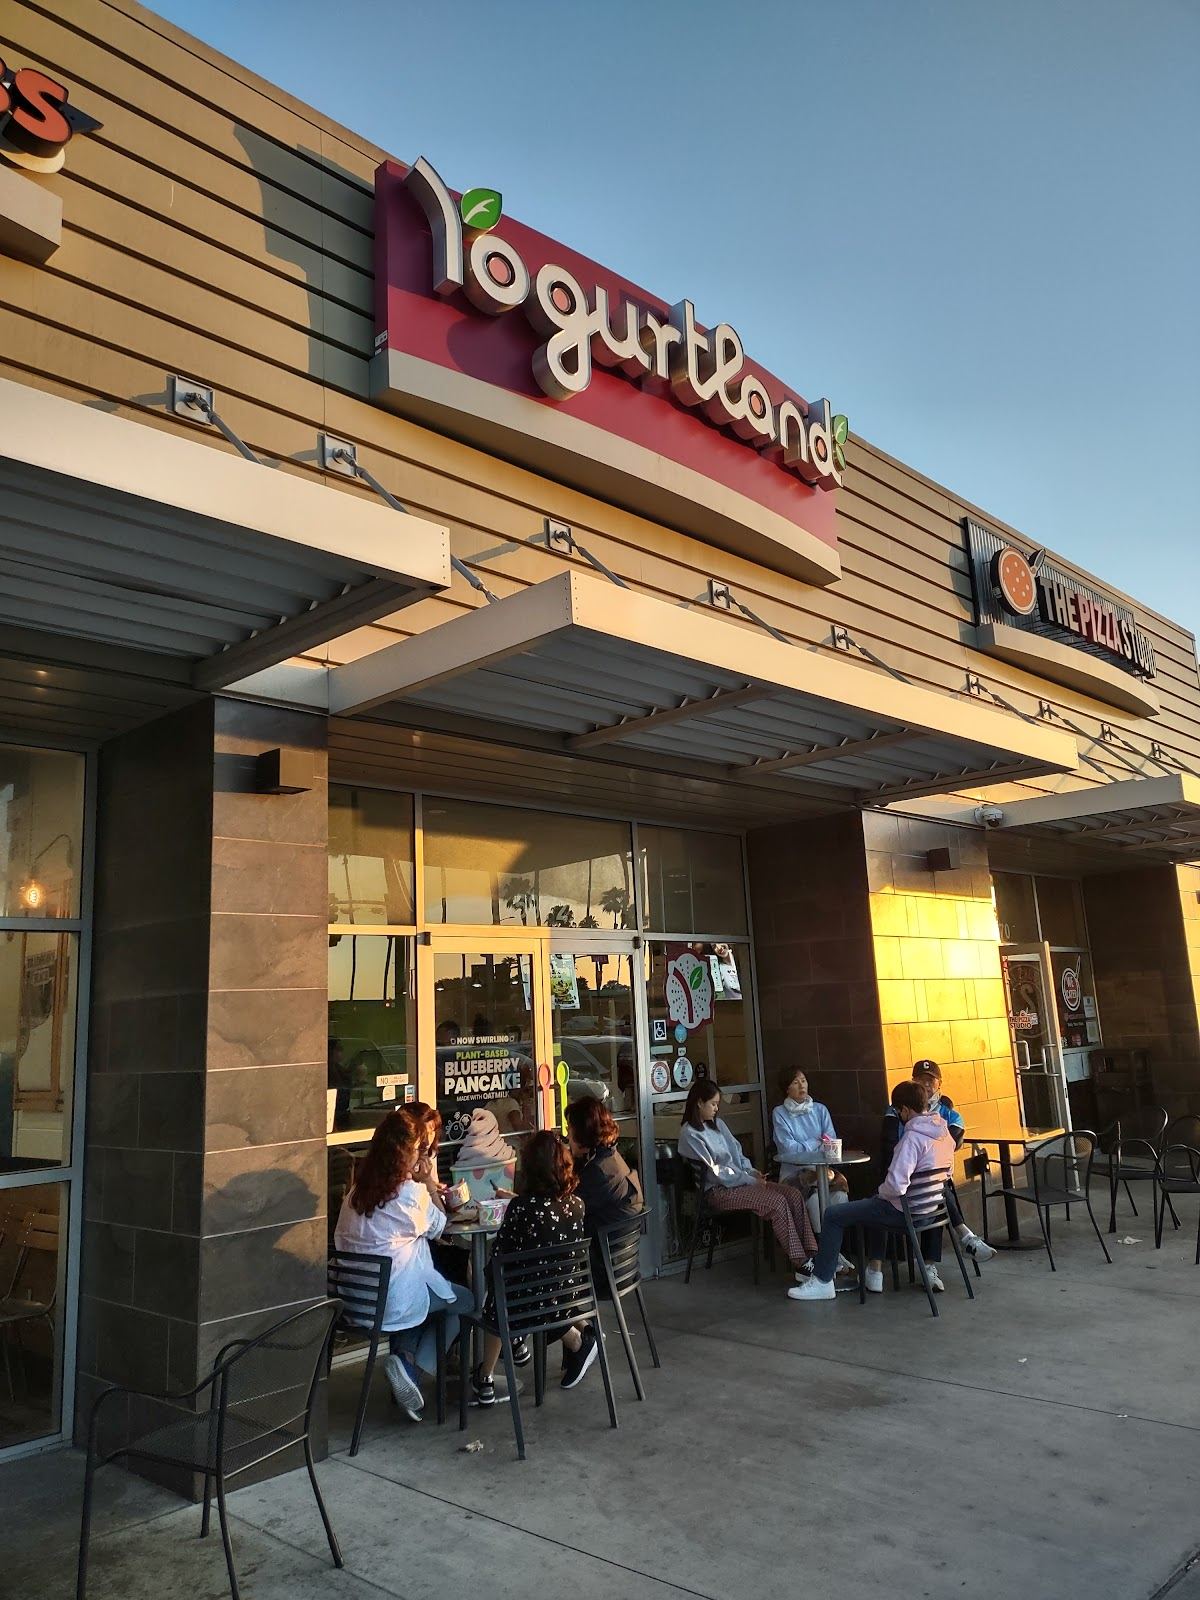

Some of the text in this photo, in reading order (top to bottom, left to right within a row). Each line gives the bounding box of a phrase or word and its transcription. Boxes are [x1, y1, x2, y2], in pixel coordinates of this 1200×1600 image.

[402, 156, 844, 488] Yogurtland
[1039, 577, 1080, 633] THE
[1077, 592, 1125, 657] PIZZA
[456, 1035, 509, 1045] NOW SWIRLING
[456, 1049, 509, 1060] PLANT-BASED
[444, 1057, 520, 1077] BLUEBERRY
[923, 1061, 930, 1069] C
[444, 1072, 521, 1095] PANCAKE
[470, 1093, 482, 1101] WITH
